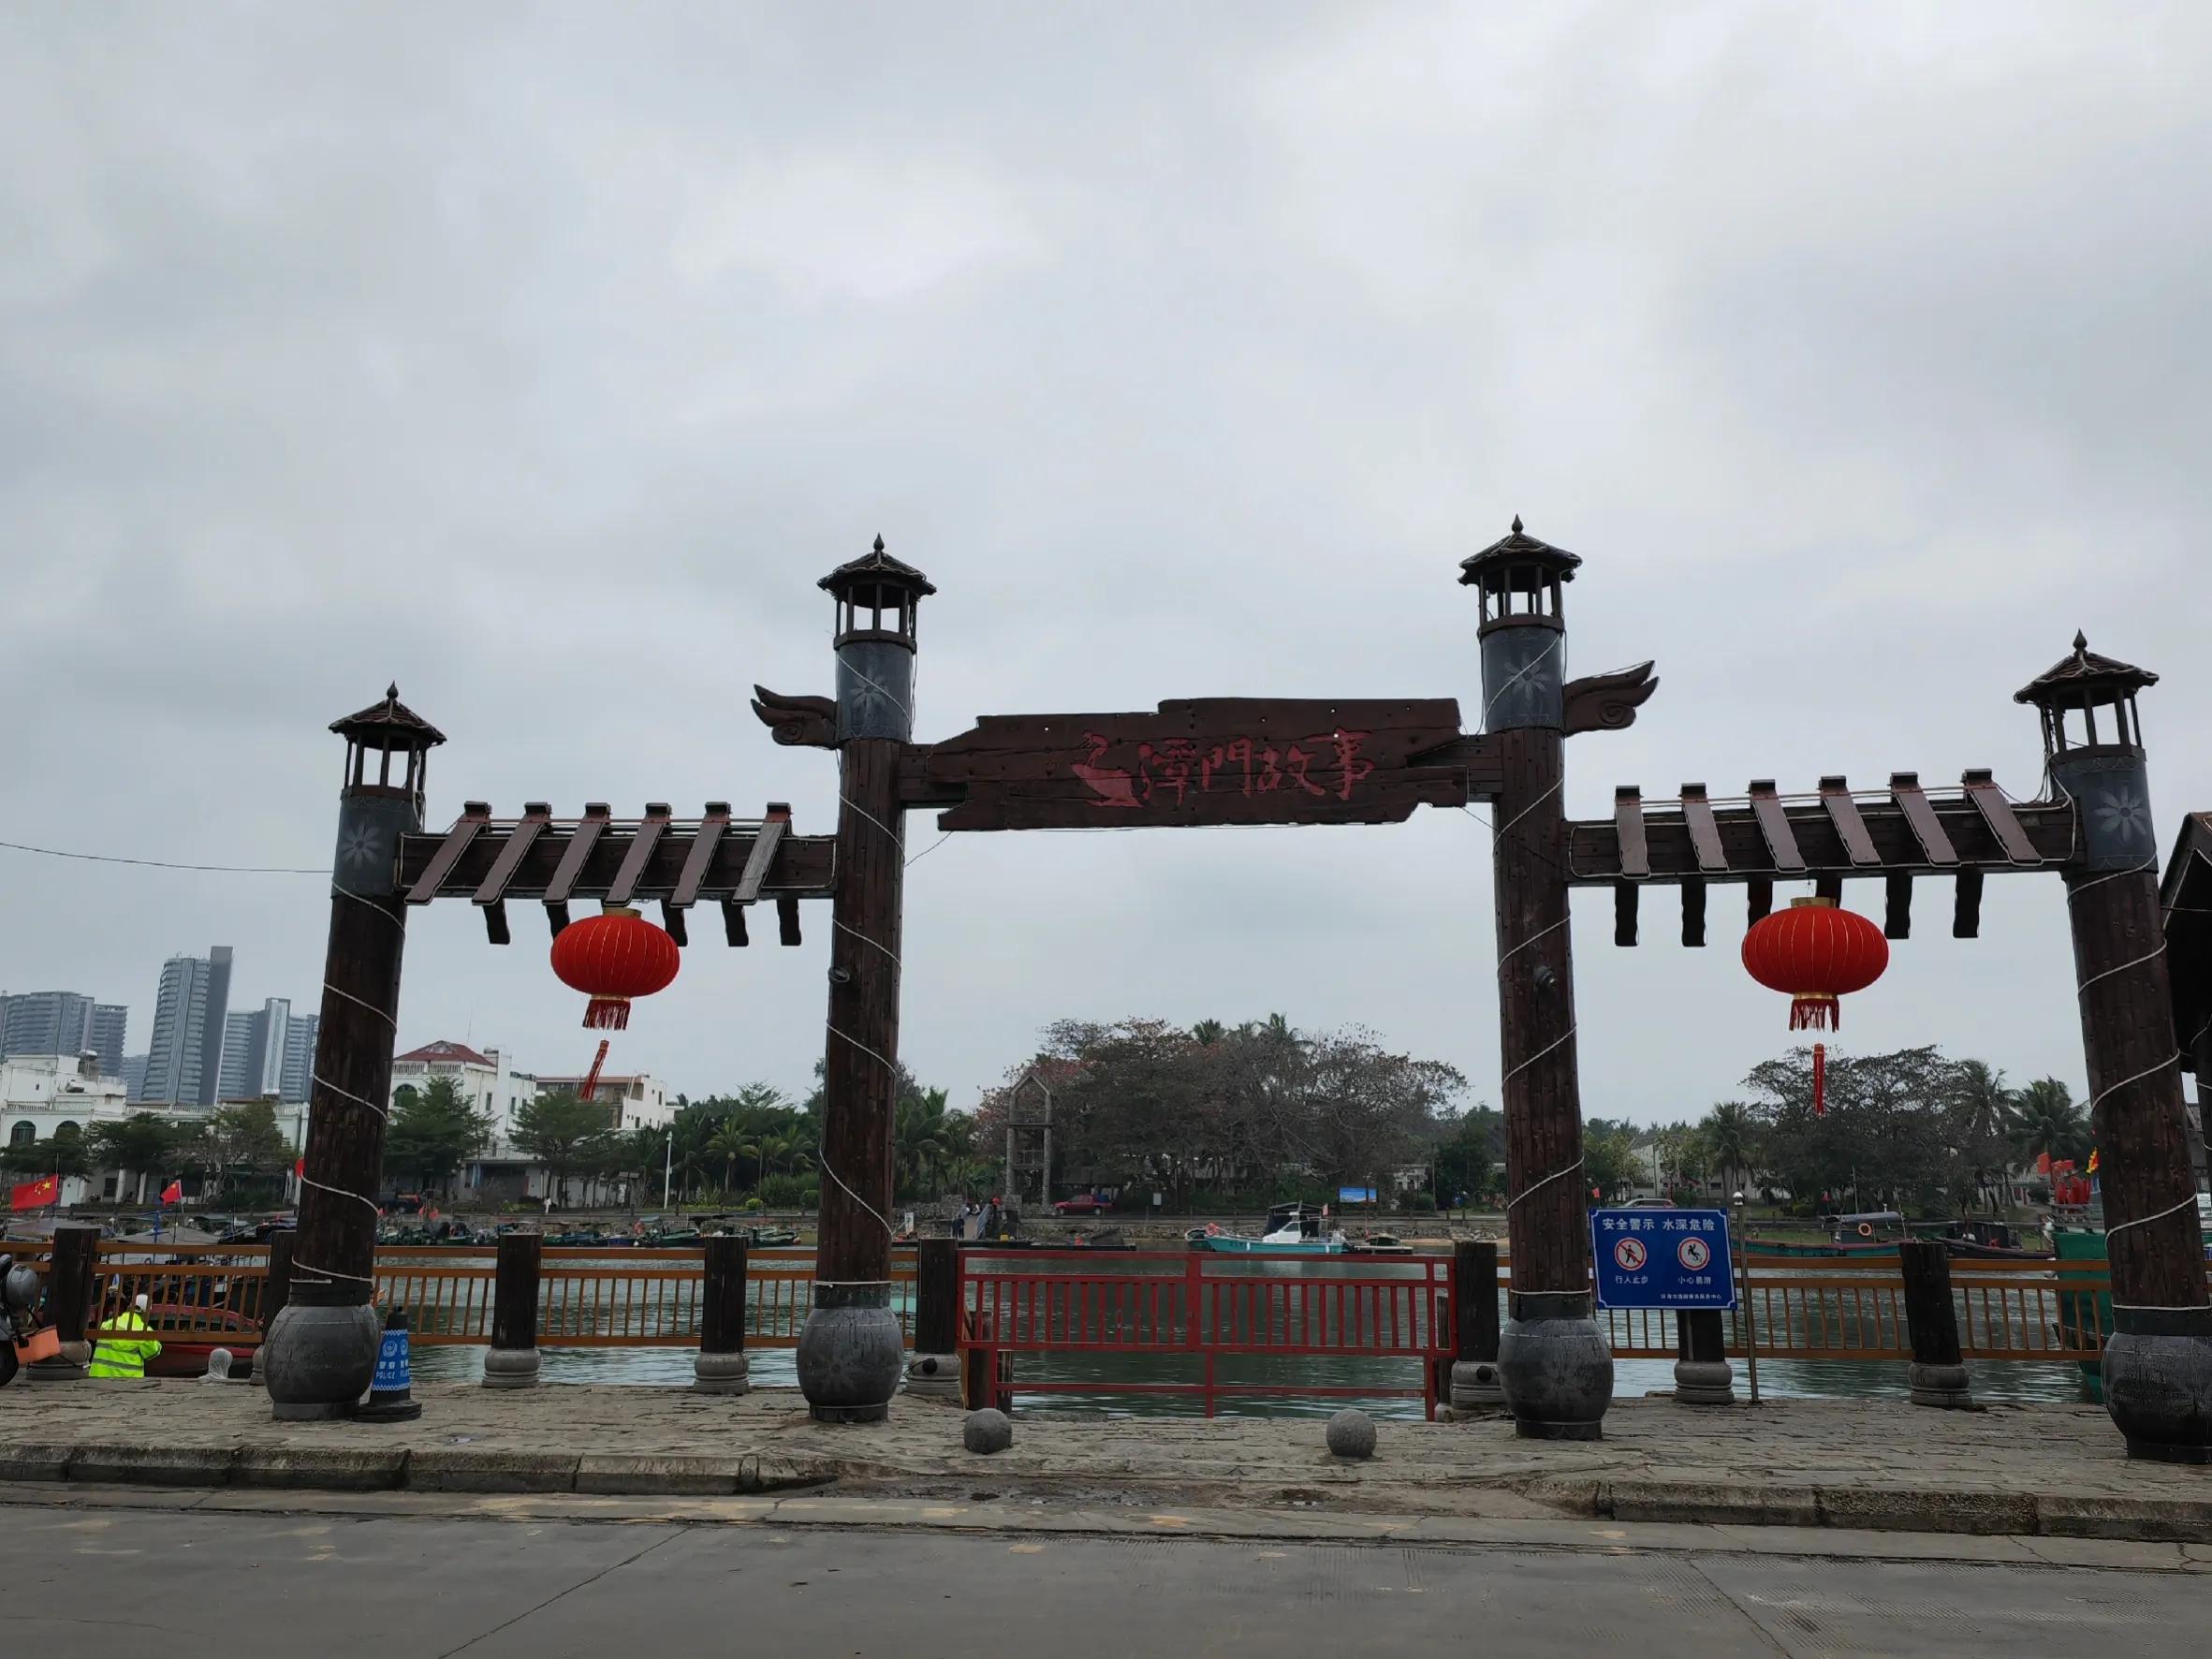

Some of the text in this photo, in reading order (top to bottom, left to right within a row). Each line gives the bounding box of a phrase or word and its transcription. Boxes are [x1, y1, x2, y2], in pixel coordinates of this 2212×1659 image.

[1602, 1218, 1715, 1231] 安全警示 水深危险
[1615, 1275, 1648, 1285] 行人止步
